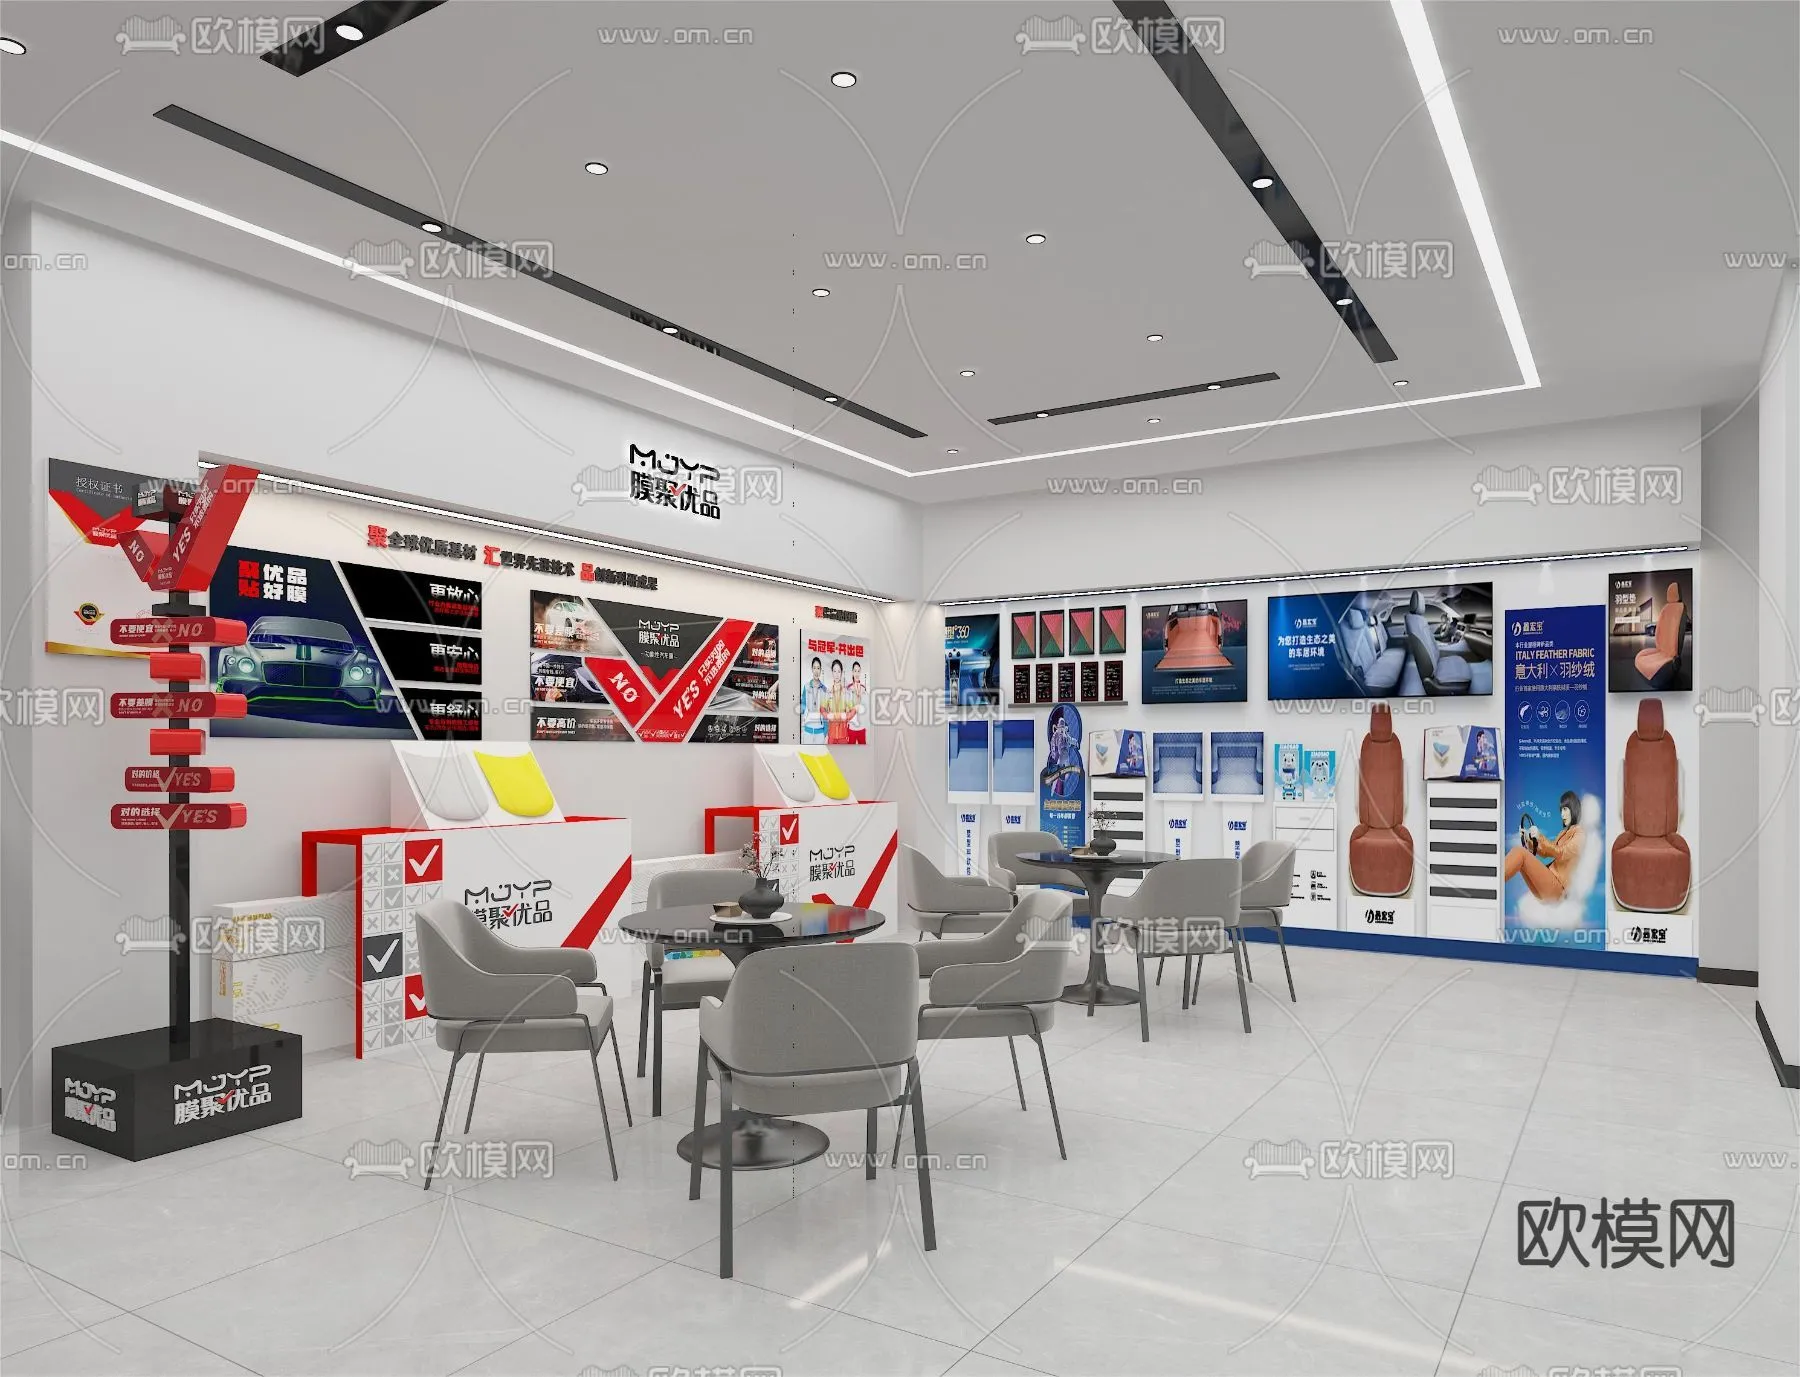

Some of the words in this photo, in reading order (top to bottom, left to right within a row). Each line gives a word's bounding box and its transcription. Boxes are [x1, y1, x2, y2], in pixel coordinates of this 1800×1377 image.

[76, 476, 122, 494] 授权证书
[630, 470, 721, 519] 膜聚优品
[128, 538, 145, 563] NO
[367, 525, 478, 562] 聚全球优质基材
[120, 624, 153, 634] 不要便宜
[176, 623, 204, 638] NO
[638, 631, 680, 648] 膜聚优品
[1278, 633, 1336, 646] 为您打造生态之美
[1289, 646, 1325, 658] 的车居环境
[1515, 650, 1535, 660] ITALY
[1535, 649, 1567, 659] FEATHER
[1568, 648, 1595, 658] FABRIC
[176, 698, 204, 713] NO
[537, 716, 576, 729] 不要高价
[120, 807, 160, 817] 对的选择
[809, 860, 855, 881] 膜聚优品
[174, 1083, 272, 1125] 膜聚优品
